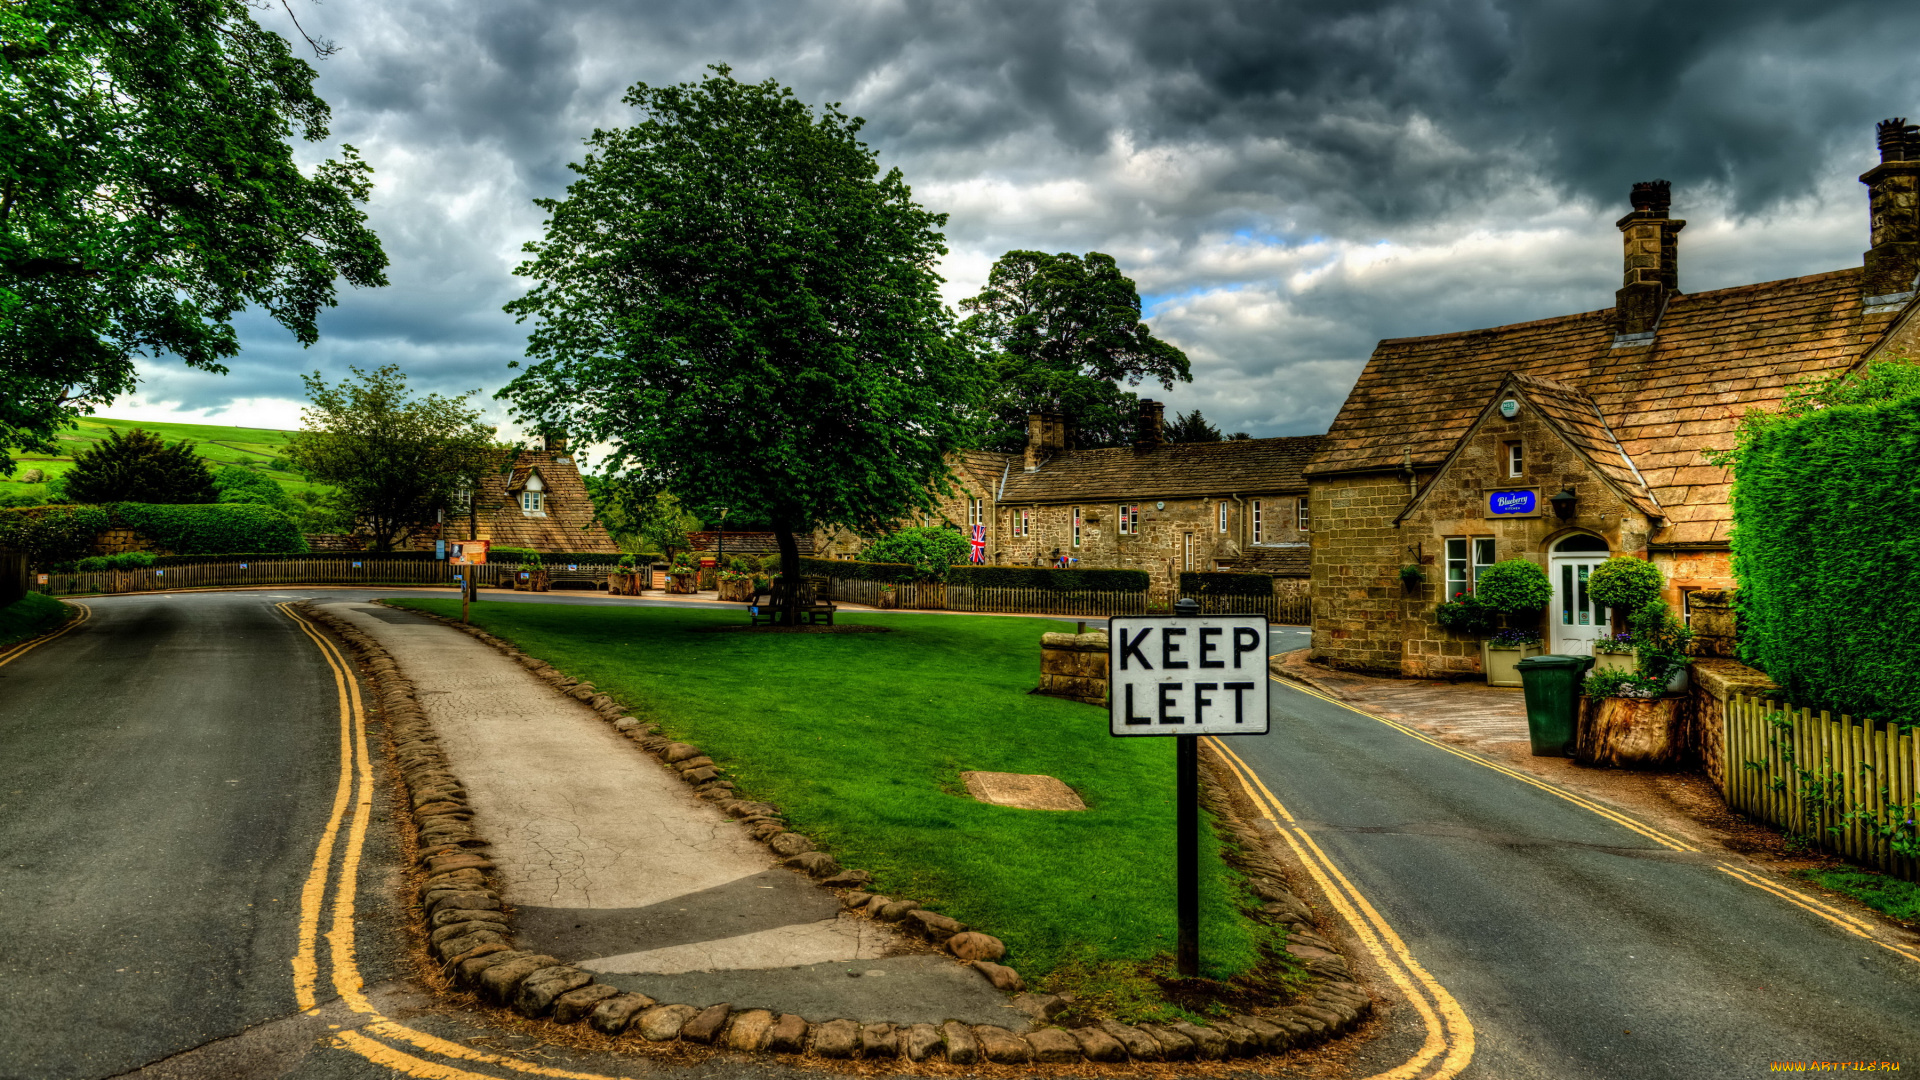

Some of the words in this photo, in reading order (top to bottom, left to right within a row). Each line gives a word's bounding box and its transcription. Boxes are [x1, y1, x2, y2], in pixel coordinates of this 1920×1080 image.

[1497, 495, 1528, 507] Blueberry
[1120, 627, 1260, 670] KEEP
[1125, 682, 1255, 725] LEFT
